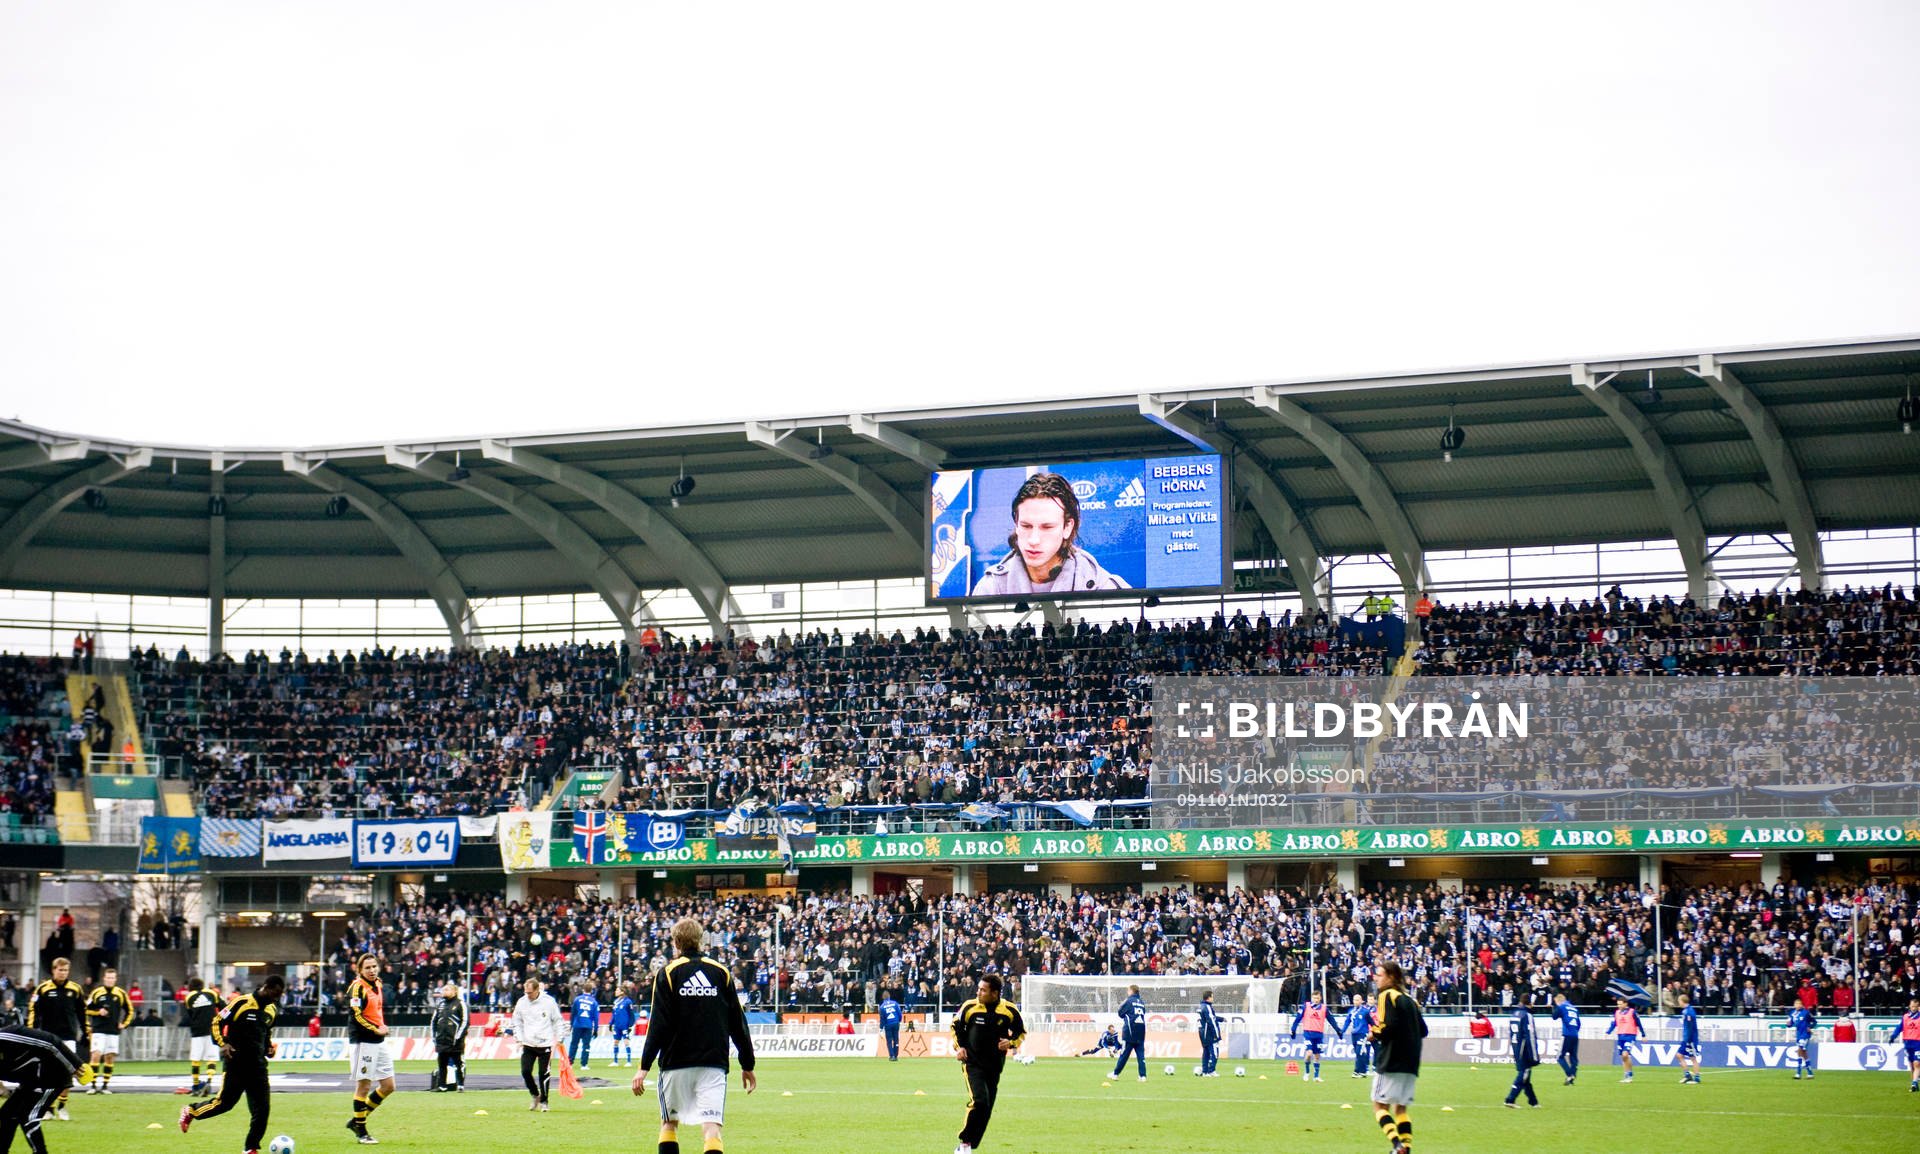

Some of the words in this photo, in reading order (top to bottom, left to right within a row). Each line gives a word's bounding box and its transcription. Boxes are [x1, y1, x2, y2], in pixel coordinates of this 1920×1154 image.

[1154, 464, 1213, 478] BEBBENS
[1074, 486, 1092, 496] KIA
[1161, 479, 1206, 492] HÖRNA
[1115, 496, 1145, 508] adida
[1172, 529, 1194, 538] med
[872, 840, 924, 858] ÅBRO
[950, 839, 1004, 856] ÅBRO
[1031, 837, 1085, 854] ÅBRO
[1113, 836, 1168, 853] ÅBRO
[1197, 834, 1253, 851] ÅBRO
[1282, 833, 1341, 850] ÅBRO
[1370, 831, 1429, 849] ÅBRO
[1459, 830, 1520, 848] ÅBRO
[1551, 829, 1612, 846] ÅBRO
[1644, 828, 1707, 845] ÅBRO
[1739, 827, 1804, 843] ÅBRO
[1836, 824, 1902, 842] ÅBRO
[679, 986, 717, 996] adidas
[281, 1041, 325, 1059] TIPS
[753, 1036, 865, 1052] STRÄNGBETONG
[1493, 1057, 1516, 1065] righ
[1726, 1045, 1806, 1067] NVS
